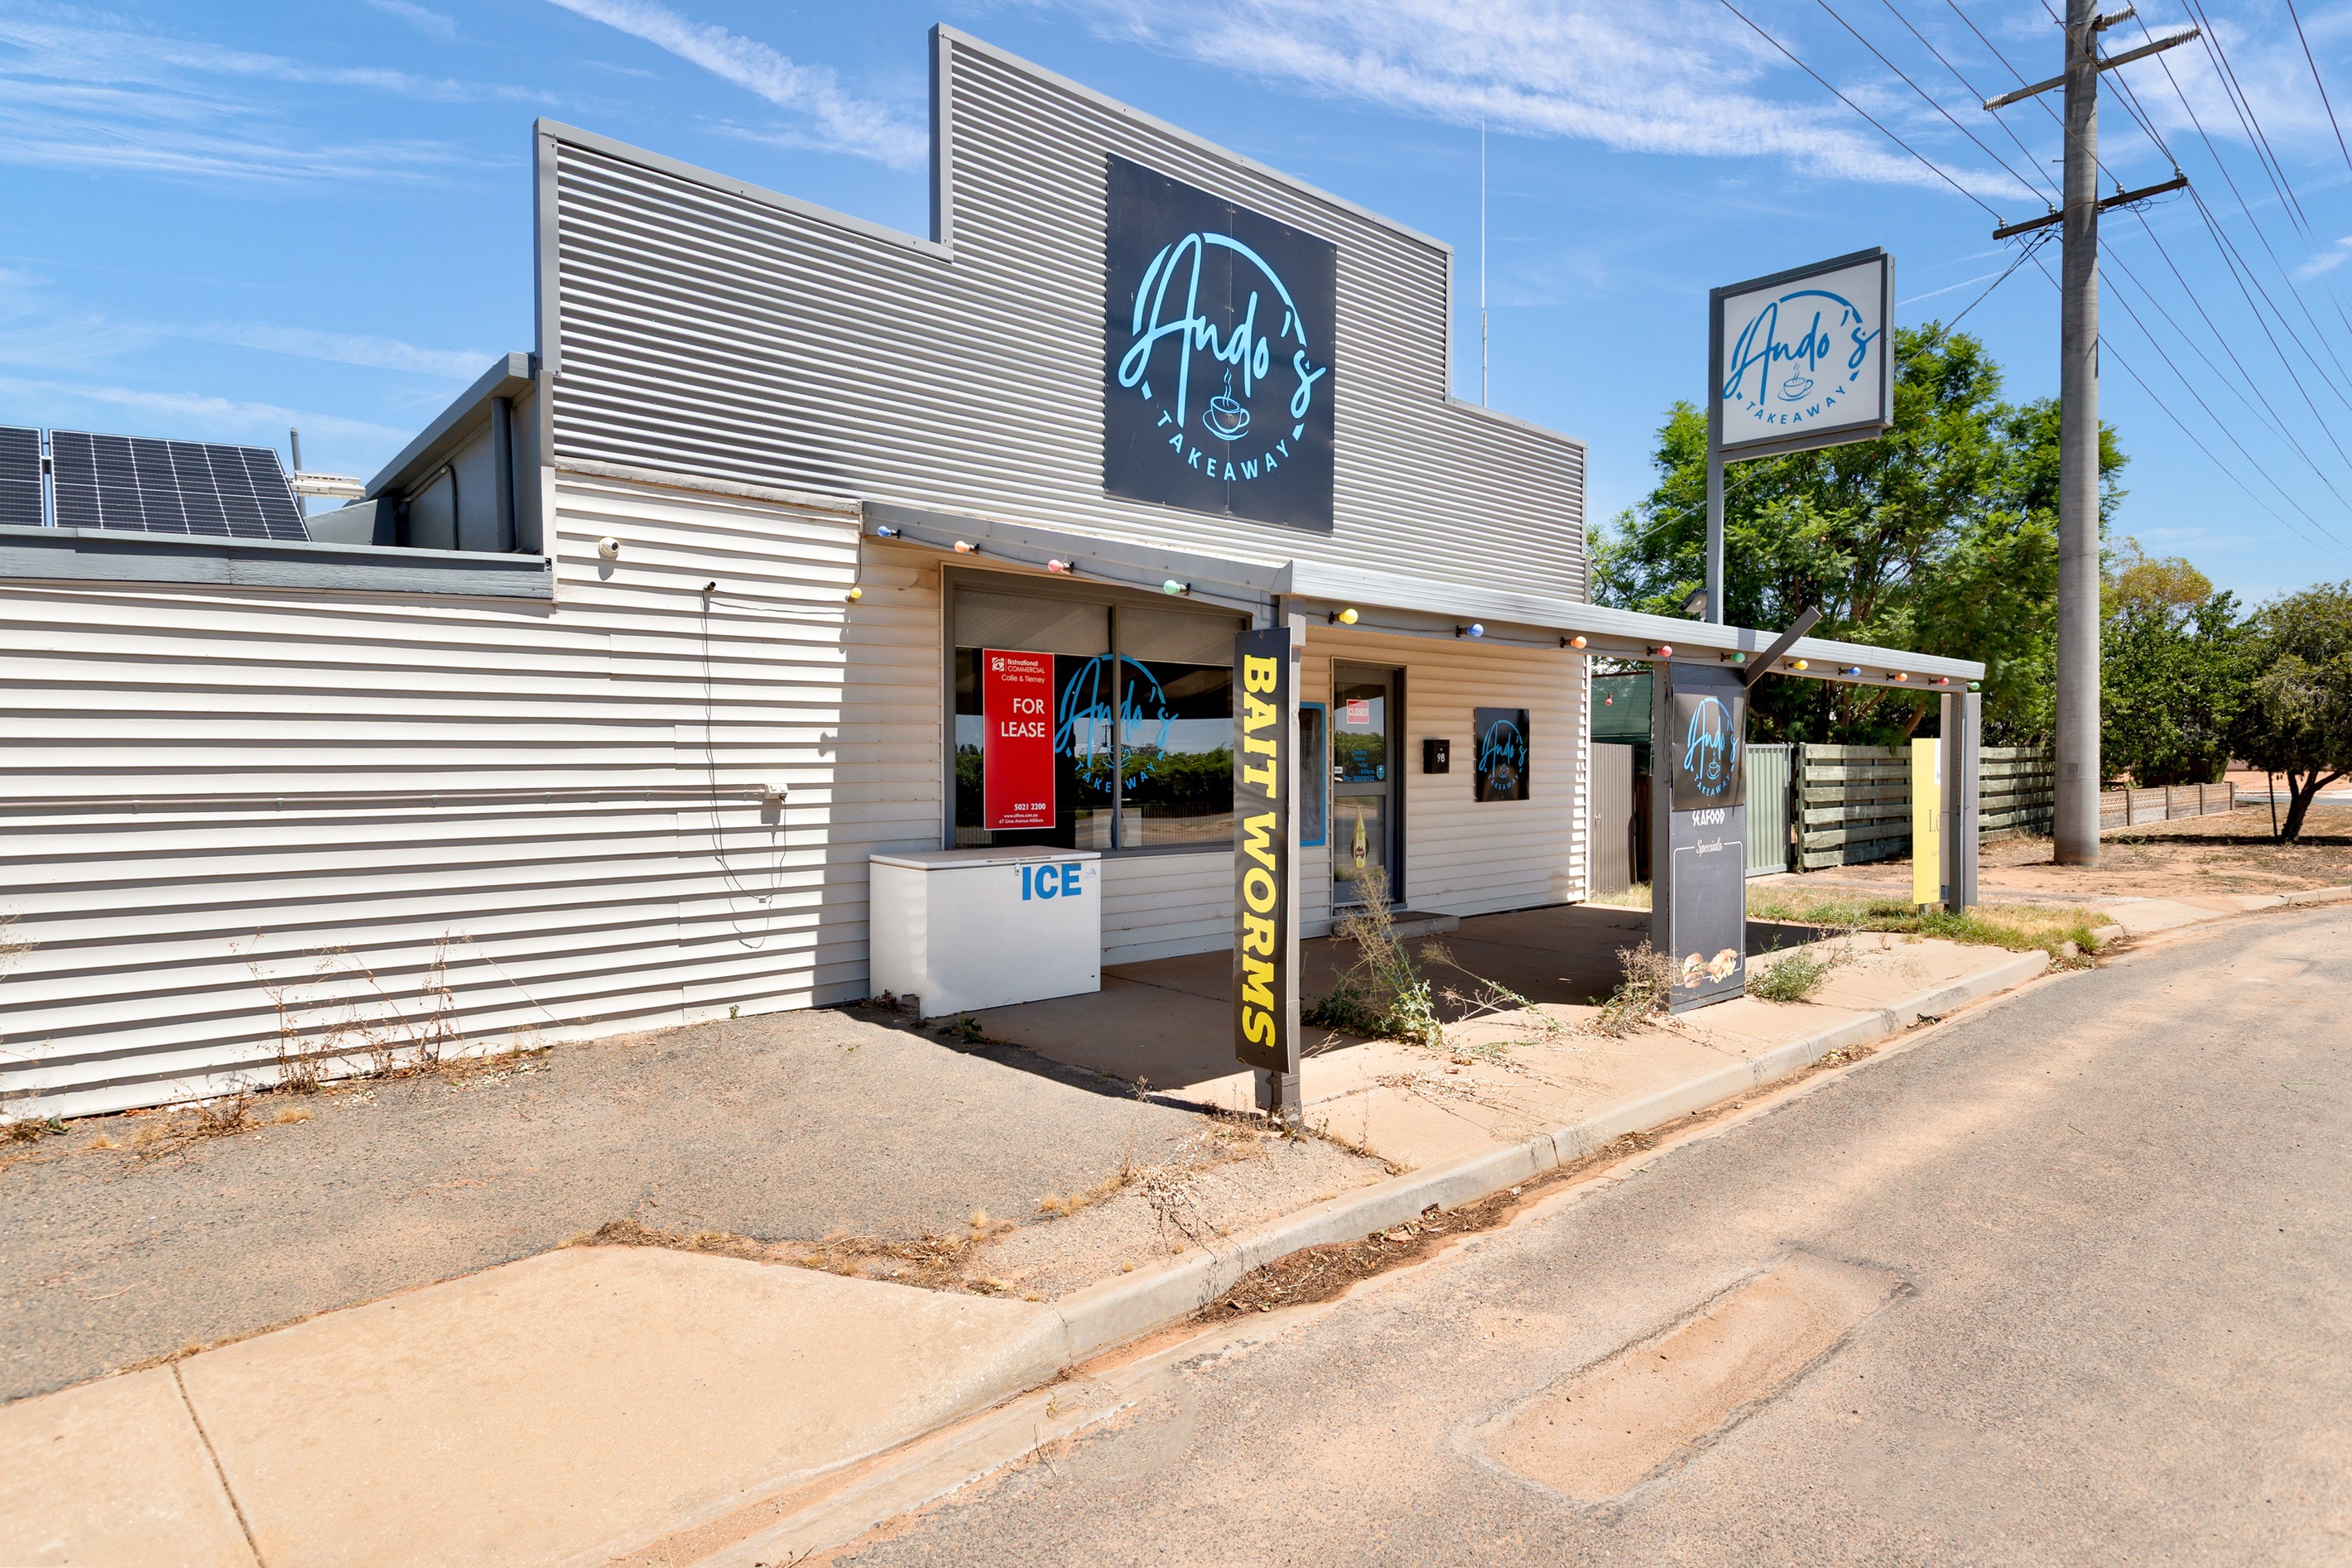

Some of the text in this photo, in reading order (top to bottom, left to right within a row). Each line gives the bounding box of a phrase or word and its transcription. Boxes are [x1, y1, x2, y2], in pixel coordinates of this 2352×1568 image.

[1118, 232, 1326, 428] Ando's
[1722, 301, 1882, 406] Ando's
[1745, 385, 1846, 425] TAKEAWAY
[1157, 409, 1291, 482] TAKEAWAY
[1008, 666, 1045, 674] COMMERCIAL
[1025, 676, 1045, 684] Tierney
[1013, 698, 1045, 714] FOR
[1349, 708, 1368, 716] CLOSED
[1001, 721, 1046, 738] LEASE
[1683, 700, 1739, 780] Ando's
[1436, 753, 1445, 762] 98
[1479, 721, 1527, 778] Ando's
[1075, 760, 1156, 793] TAKEWAY
[1488, 773, 1519, 791] TAKEAWAY
[1694, 773, 1730, 796] TAKEAWAY
[1692, 808, 1725, 827] SEAFOOD
[1242, 654, 1277, 1048] BAIT WORMS
[1695, 836, 1724, 858] Specials
[1022, 863, 1082, 901] ICE
